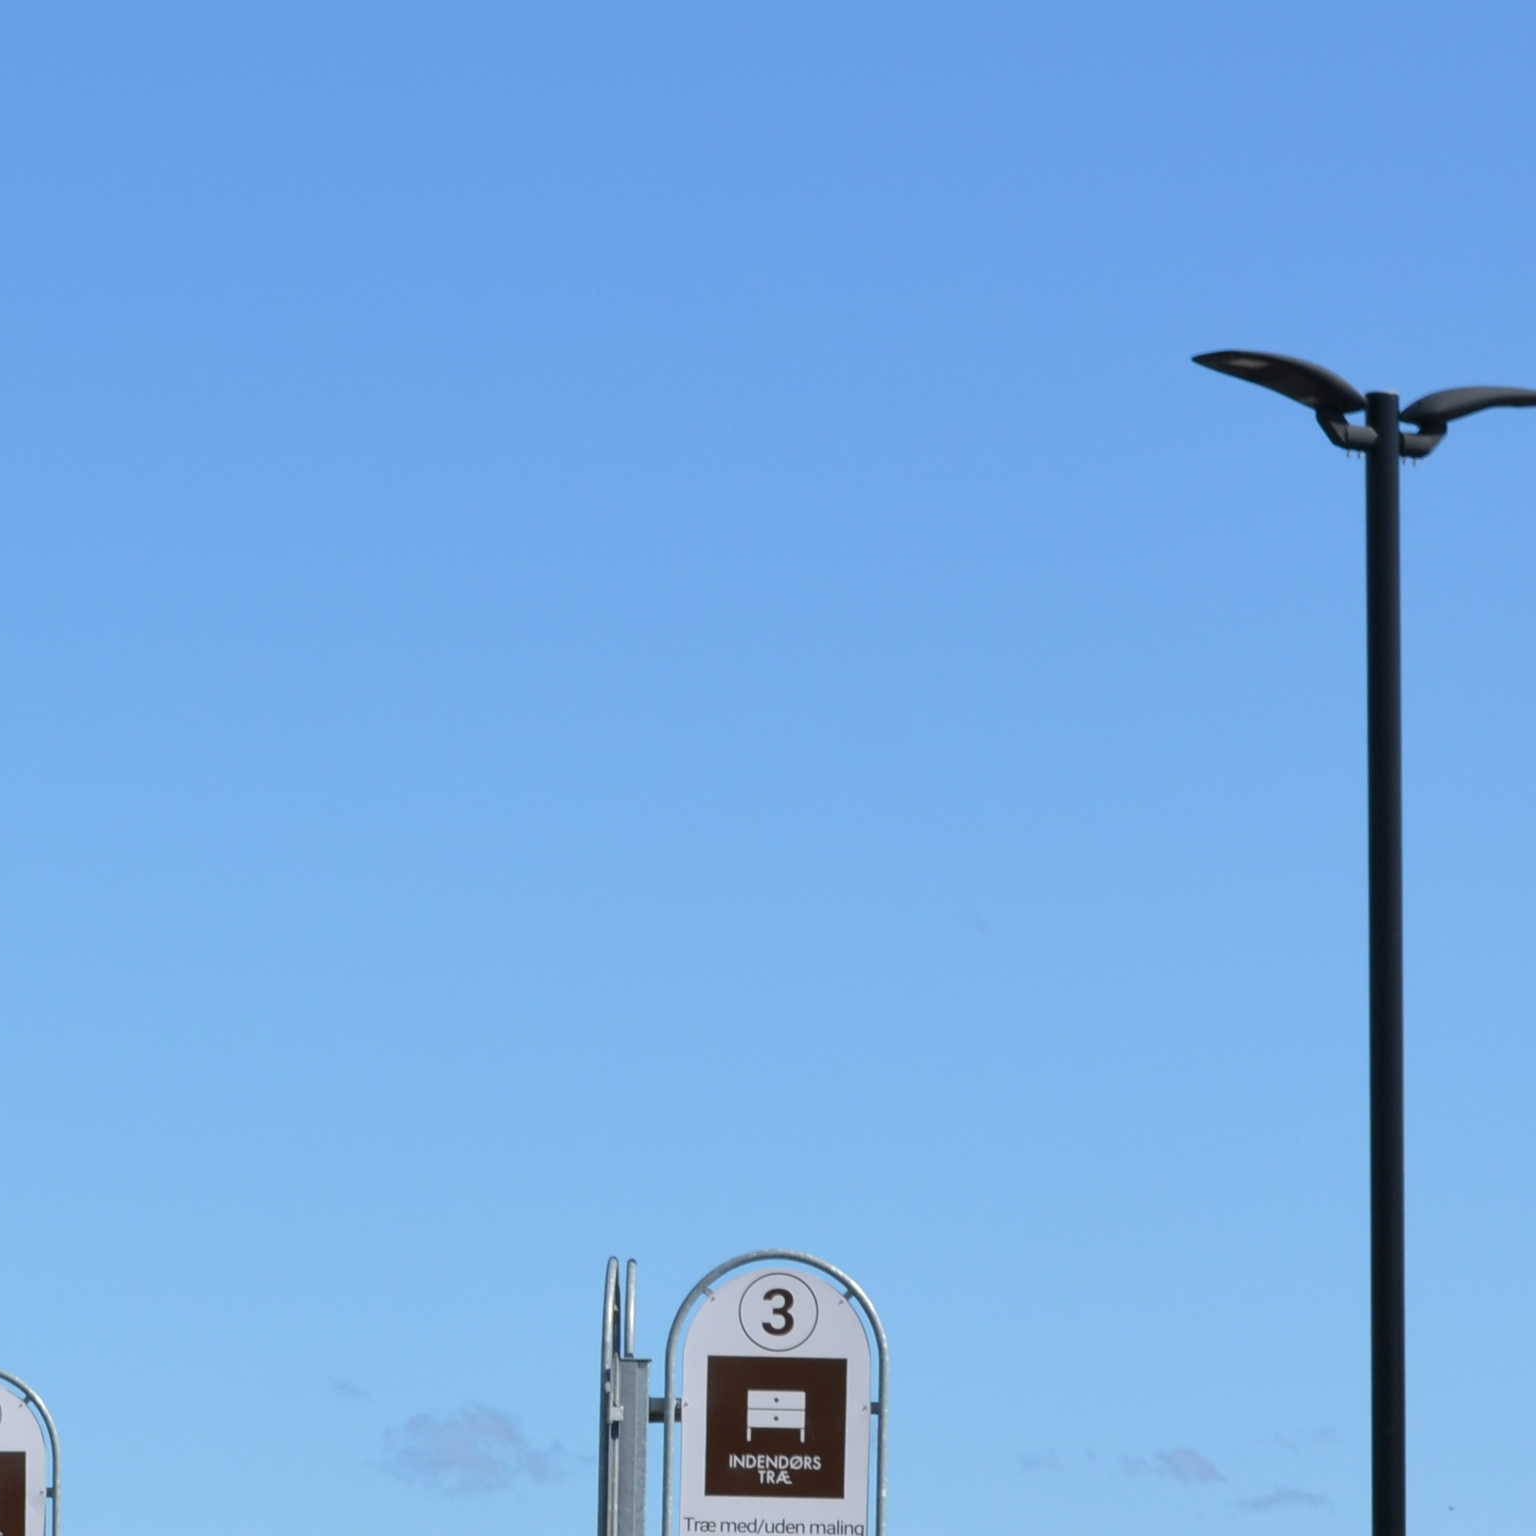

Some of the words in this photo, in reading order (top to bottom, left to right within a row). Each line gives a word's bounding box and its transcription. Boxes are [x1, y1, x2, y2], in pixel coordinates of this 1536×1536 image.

[762, 1289, 794, 1335] 3
[729, 1454, 821, 1470] INDENDØRS
[759, 1470, 792, 1485] TRÆ
[684, 1517, 716, 1533] Træ
[720, 1518, 805, 1535] med/uden
